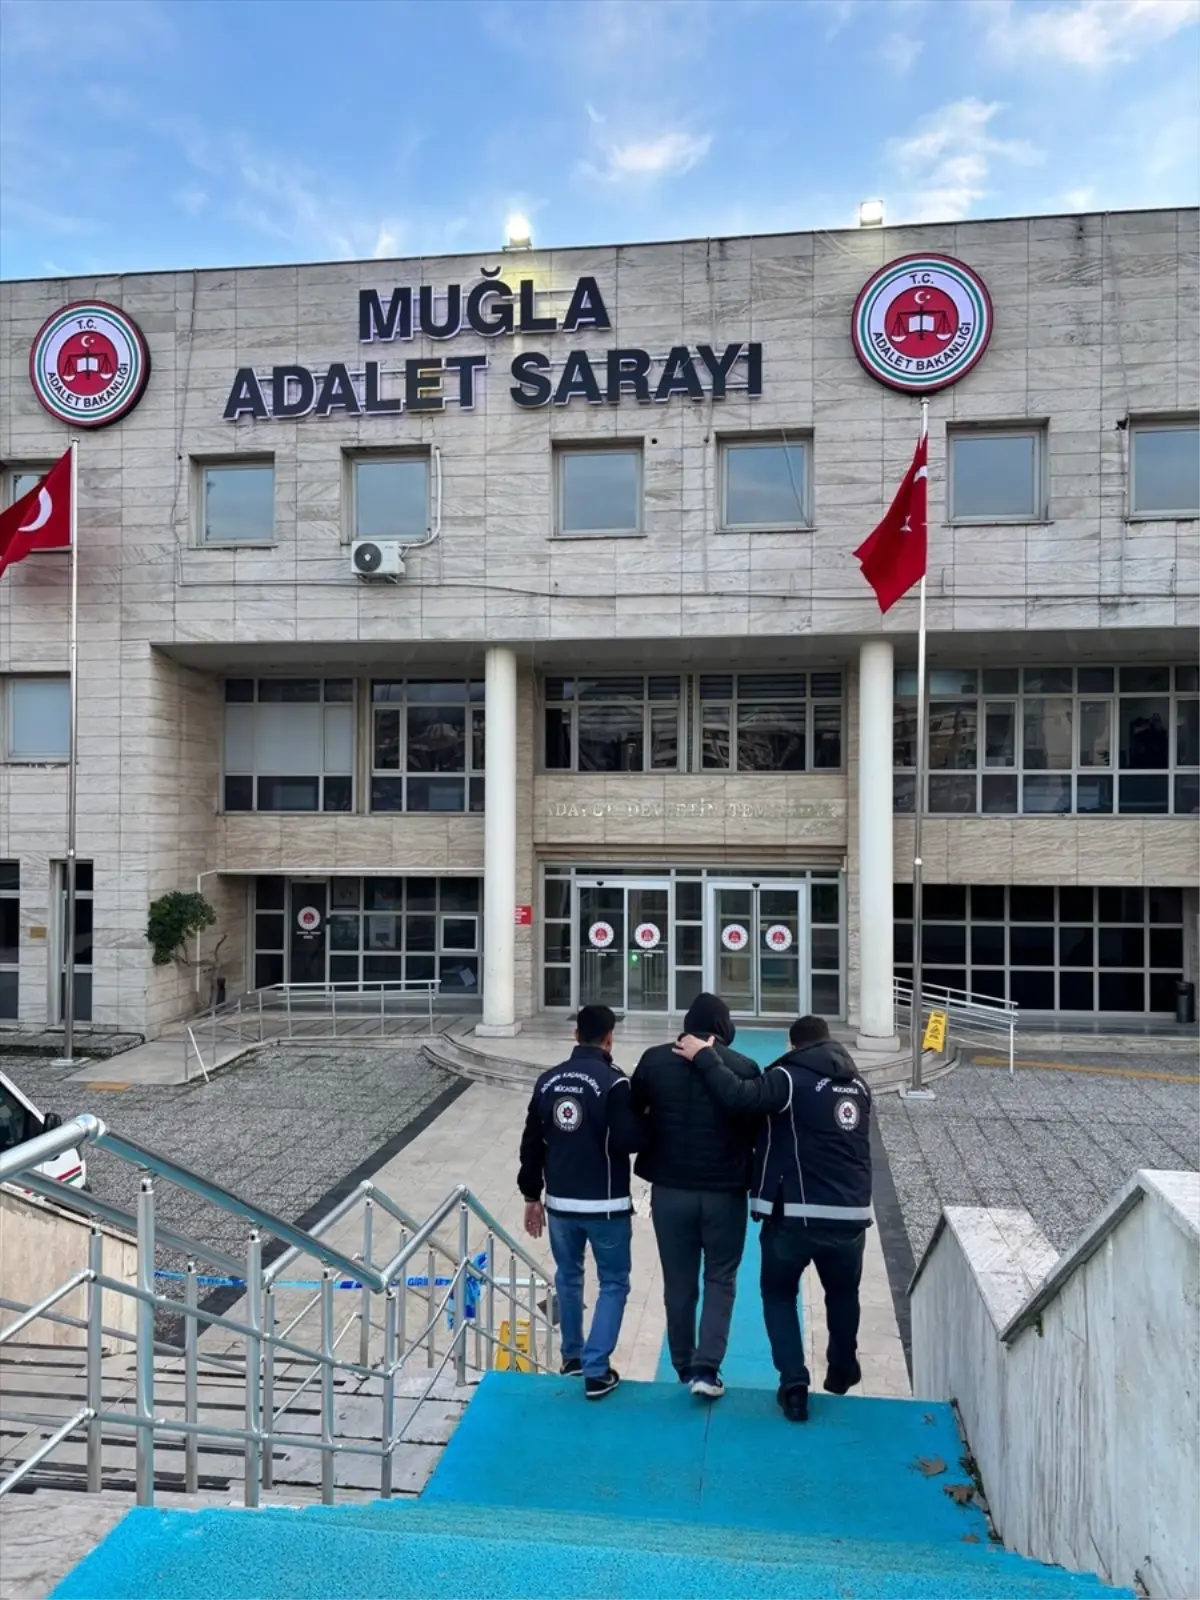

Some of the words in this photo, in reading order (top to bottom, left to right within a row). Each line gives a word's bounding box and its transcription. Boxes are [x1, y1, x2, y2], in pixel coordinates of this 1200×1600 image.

[908, 273, 934, 285] T.C.
[76, 319, 97, 330] T.C.
[359, 266, 611, 342] MUĞLA
[873, 331, 913, 370] ADALET
[915, 322, 972, 371] BAKANLIĞI
[47, 371, 82, 407] ADALET
[83, 363, 129, 408] BAKANLIĞI
[222, 355, 488, 421] ADALET
[510, 343, 763, 408] SARAYI
